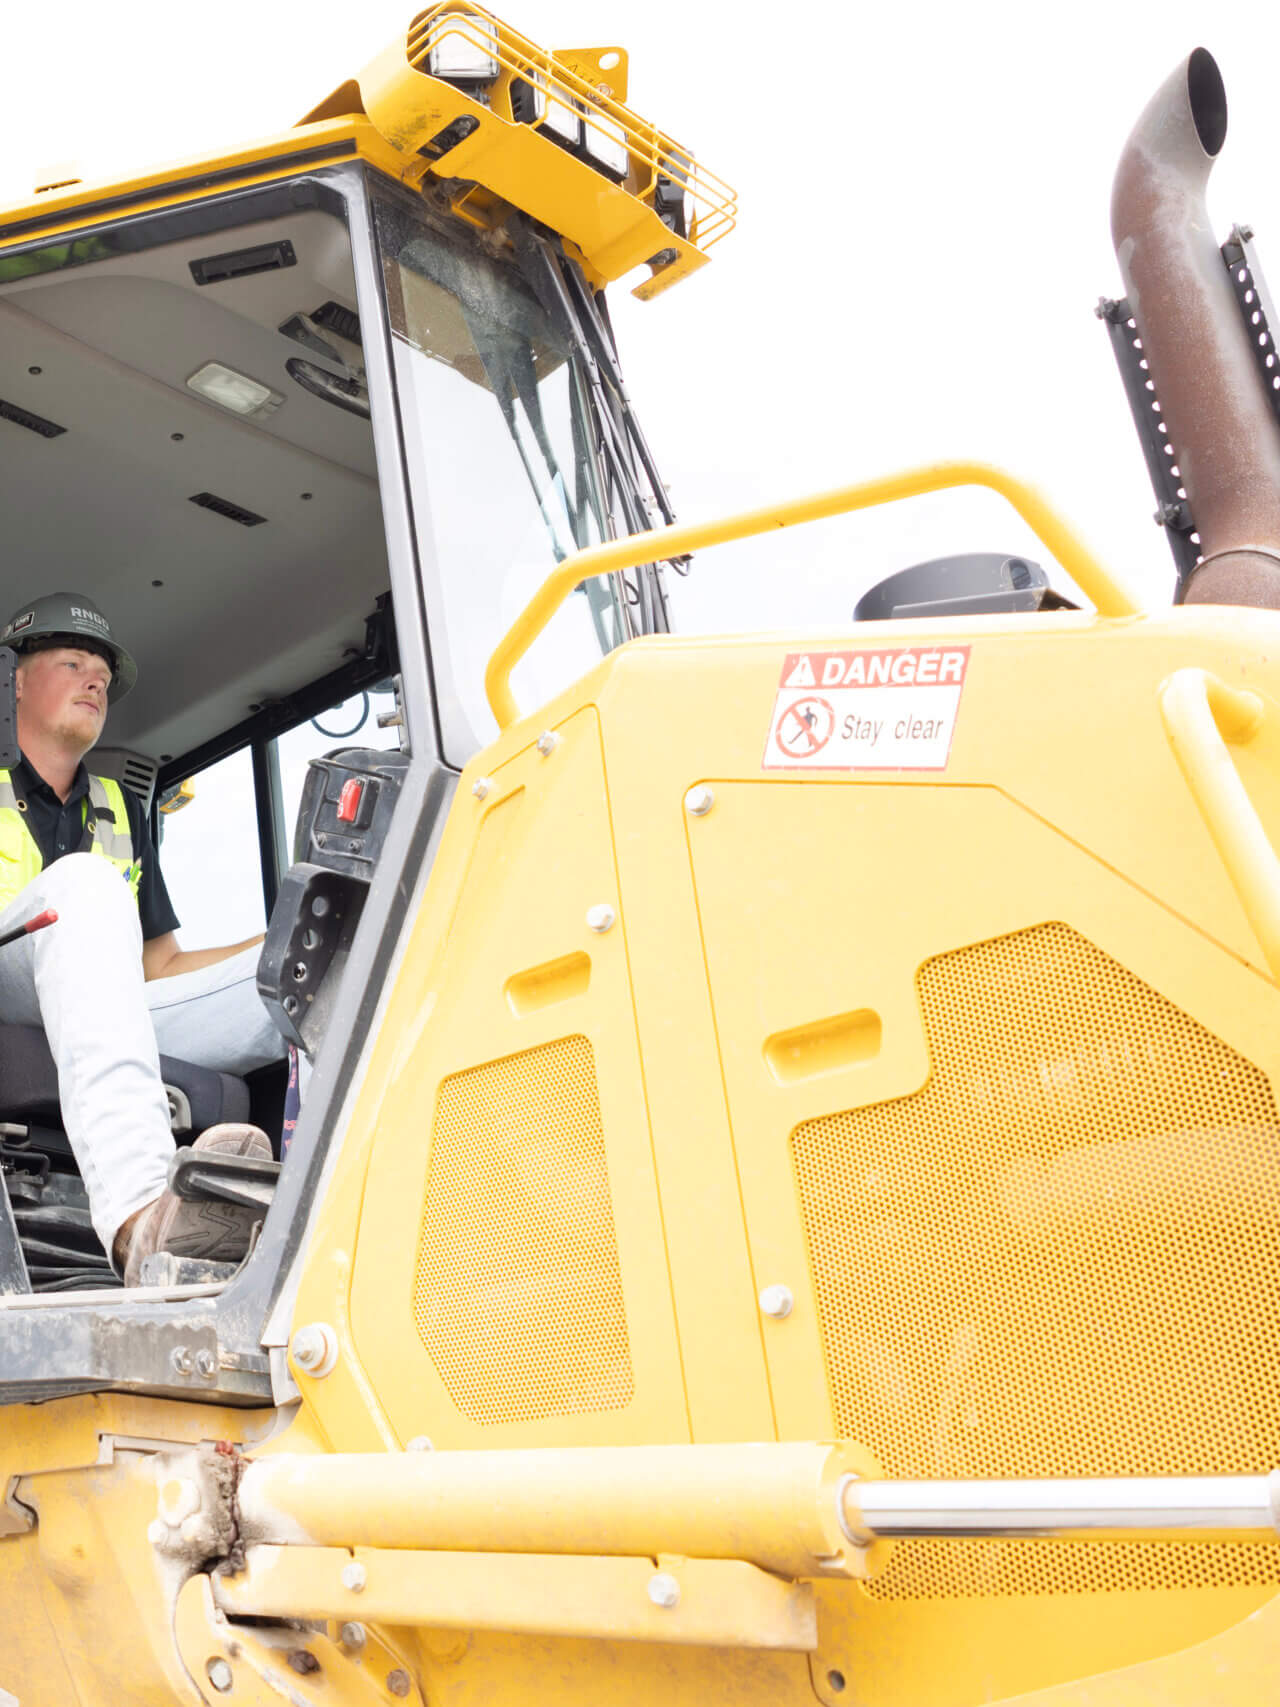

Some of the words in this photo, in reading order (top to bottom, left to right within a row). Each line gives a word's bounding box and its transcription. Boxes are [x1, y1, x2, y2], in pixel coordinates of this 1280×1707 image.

[821, 652, 965, 686] DANGER
[841, 713, 884, 747] Stay
[894, 714, 944, 740] clear
